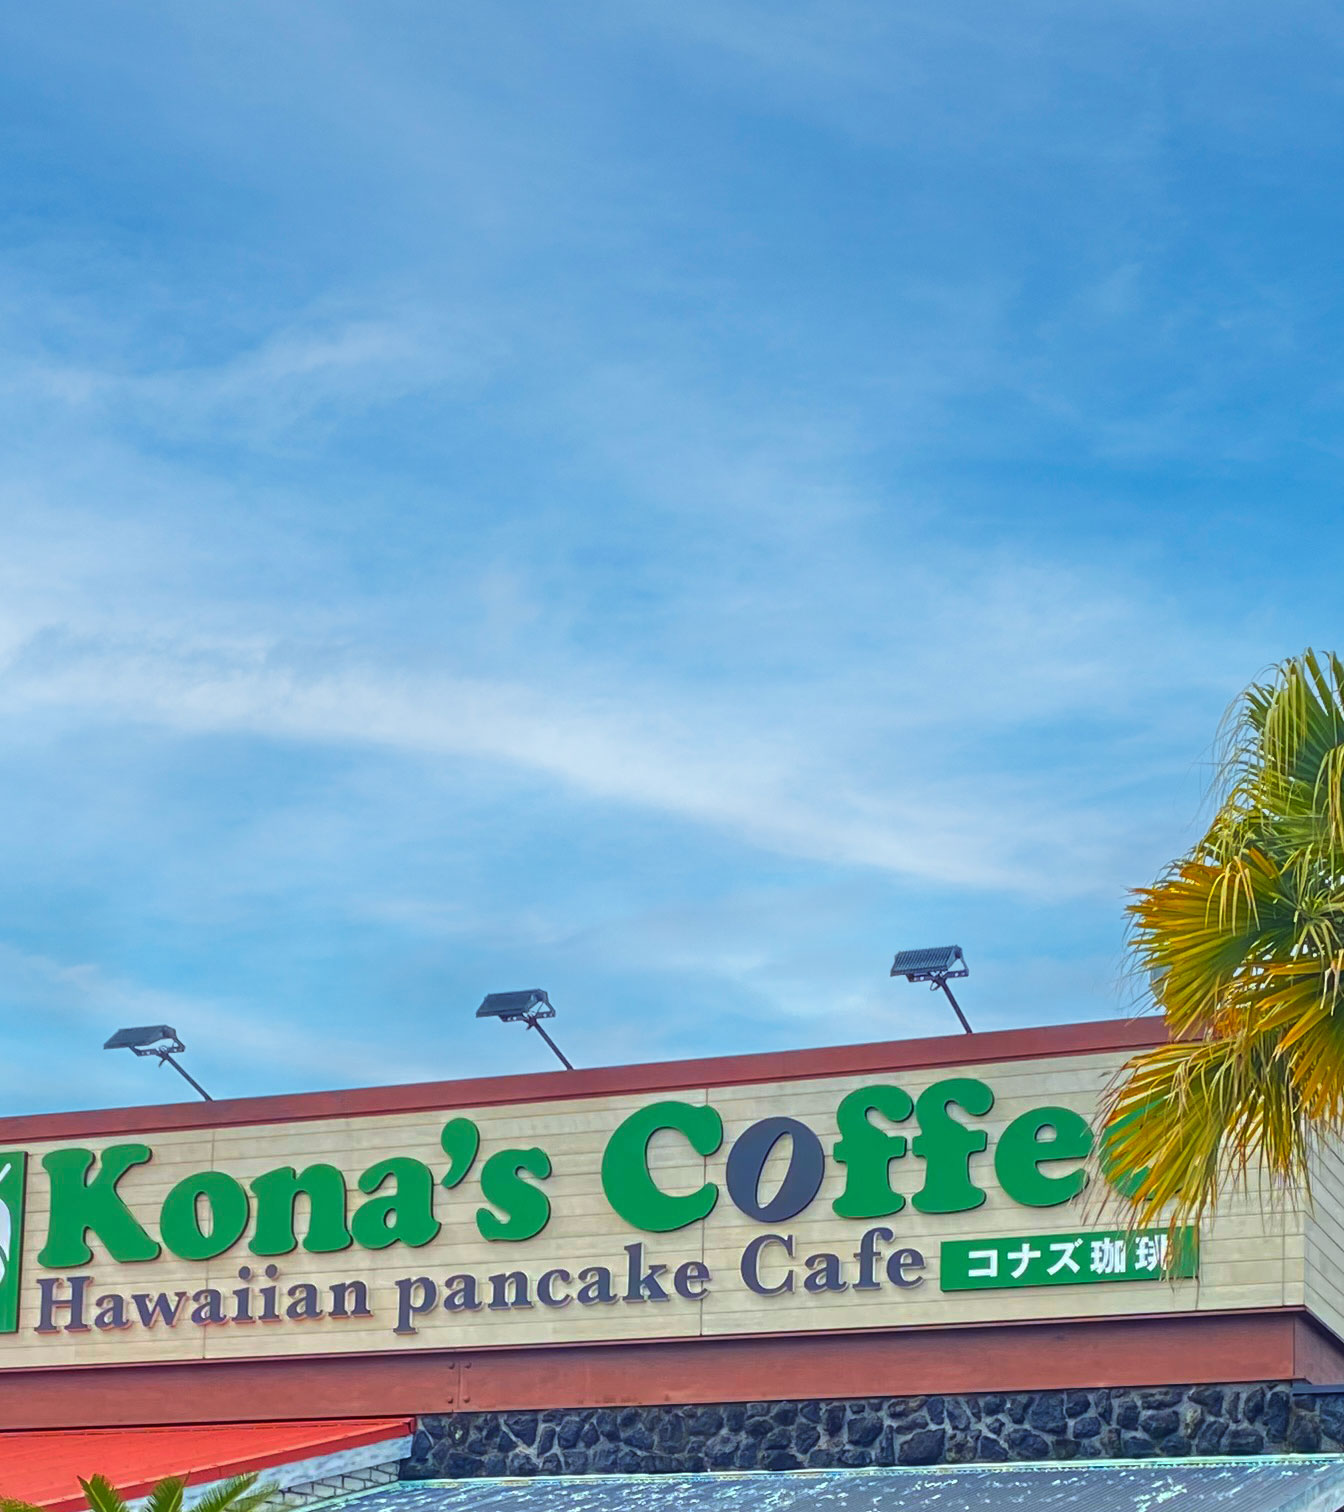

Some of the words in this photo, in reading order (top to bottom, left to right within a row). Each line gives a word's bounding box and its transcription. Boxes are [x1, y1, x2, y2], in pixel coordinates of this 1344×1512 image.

[38, 1117, 552, 1267] Kona's
[35, 1263, 373, 1333] Hawaiian
[393, 1244, 709, 1334] pancake
[740, 1227, 926, 1295] Cafe
[967, 1235, 1171, 1280] コナズ珈琲
